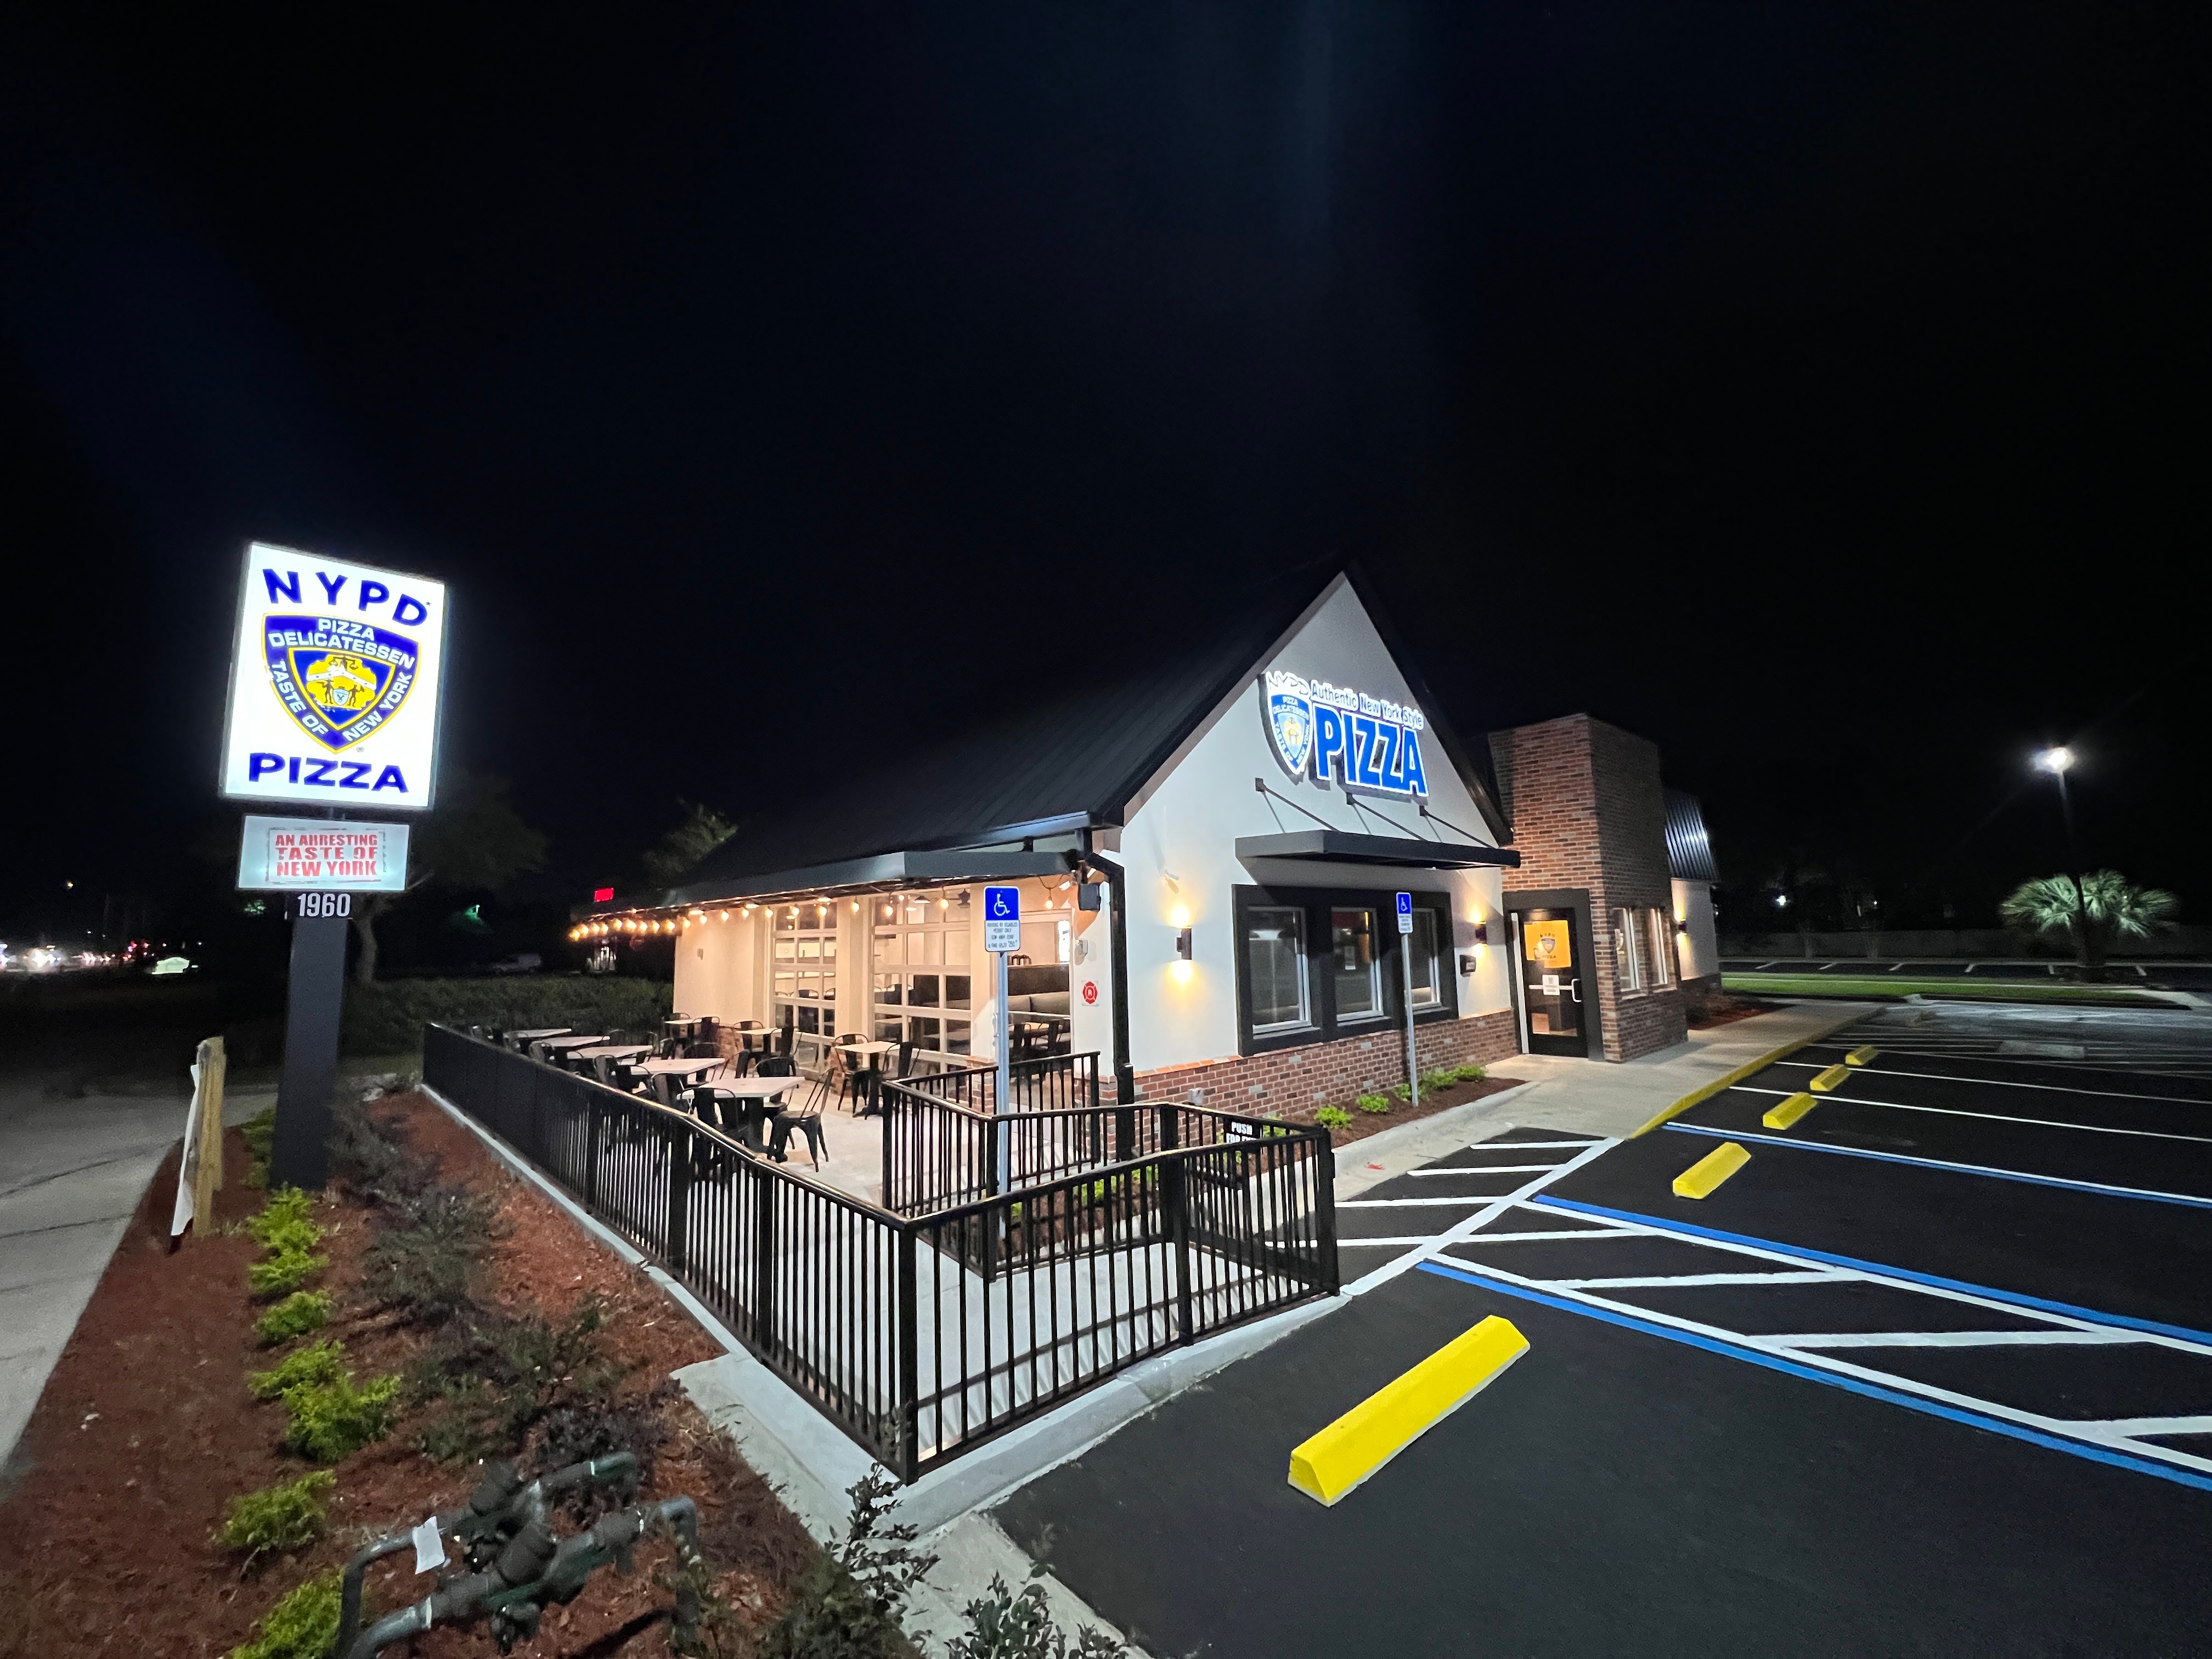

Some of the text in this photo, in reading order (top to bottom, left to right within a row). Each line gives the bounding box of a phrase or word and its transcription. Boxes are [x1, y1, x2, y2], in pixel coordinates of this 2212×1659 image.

[262, 568, 428, 626] NYPD
[318, 618, 375, 641] PIZZA
[268, 631, 415, 669] DELICATESSEN
[271, 659, 329, 735] TASTE OF
[342, 672, 412, 741] NEW YORK
[1312, 682, 1423, 729] Authentic New York Style
[1312, 703, 1429, 797] PIZZA
[249, 752, 409, 793] PIZZA
[275, 834, 295, 846] AN
[275, 847, 378, 860] TASTE OF
[276, 860, 377, 877] NEW YORK
[297, 893, 351, 917] 1960
[1231, 1121, 1252, 1136] PUSH
